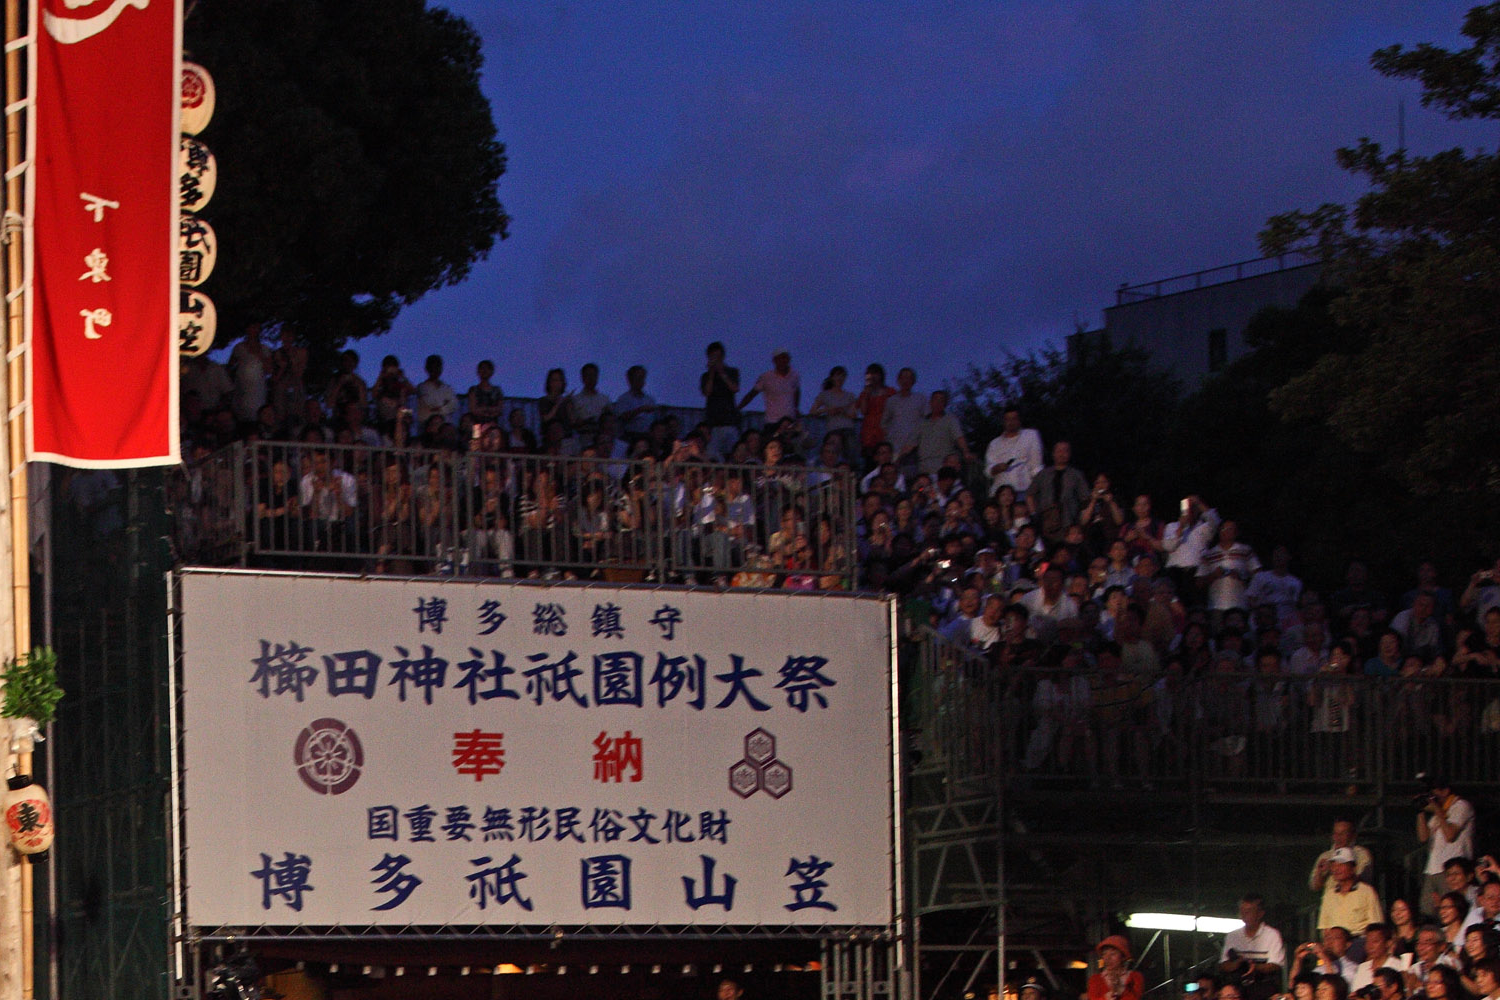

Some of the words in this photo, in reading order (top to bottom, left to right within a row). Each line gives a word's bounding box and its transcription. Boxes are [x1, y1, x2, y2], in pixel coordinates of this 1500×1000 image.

[412, 595, 684, 641] 博多総鎮守
[249, 638, 838, 712] 櫛田神社祇園例大祭
[452, 728, 644, 784] 奉納
[17, 803, 45, 833] 東
[367, 804, 731, 845] 国重要無形民俗文化財
[250, 851, 838, 912] 博多祇園山笠
